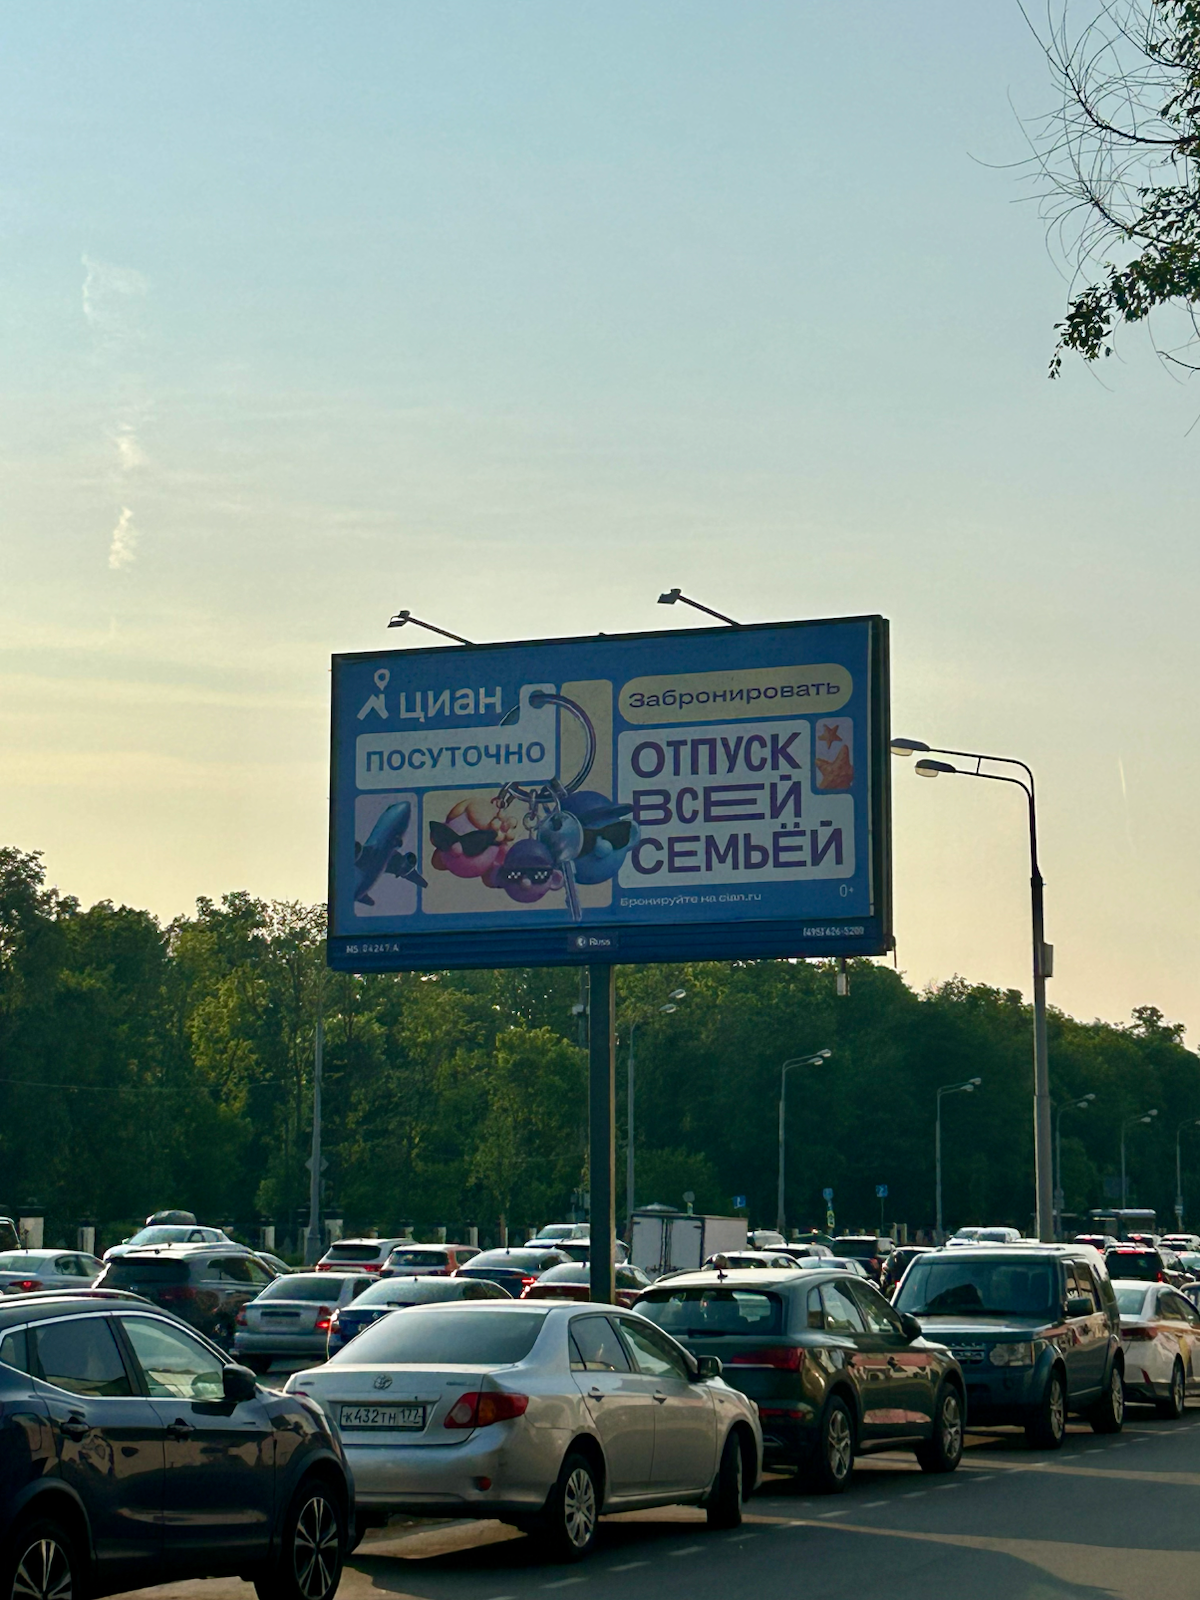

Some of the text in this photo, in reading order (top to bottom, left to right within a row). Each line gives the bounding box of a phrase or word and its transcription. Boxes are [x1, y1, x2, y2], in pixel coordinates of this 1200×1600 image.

[628, 682, 841, 709] Забронировать
[631, 732, 802, 778] ОТПУСК
[632, 774, 802, 826] ВСЕЙ
[631, 820, 843, 875] СЕМЬЁЙ
[620, 893, 762, 908] Бронируйте на cian.ru
[839, 884, 854, 897] 0+
